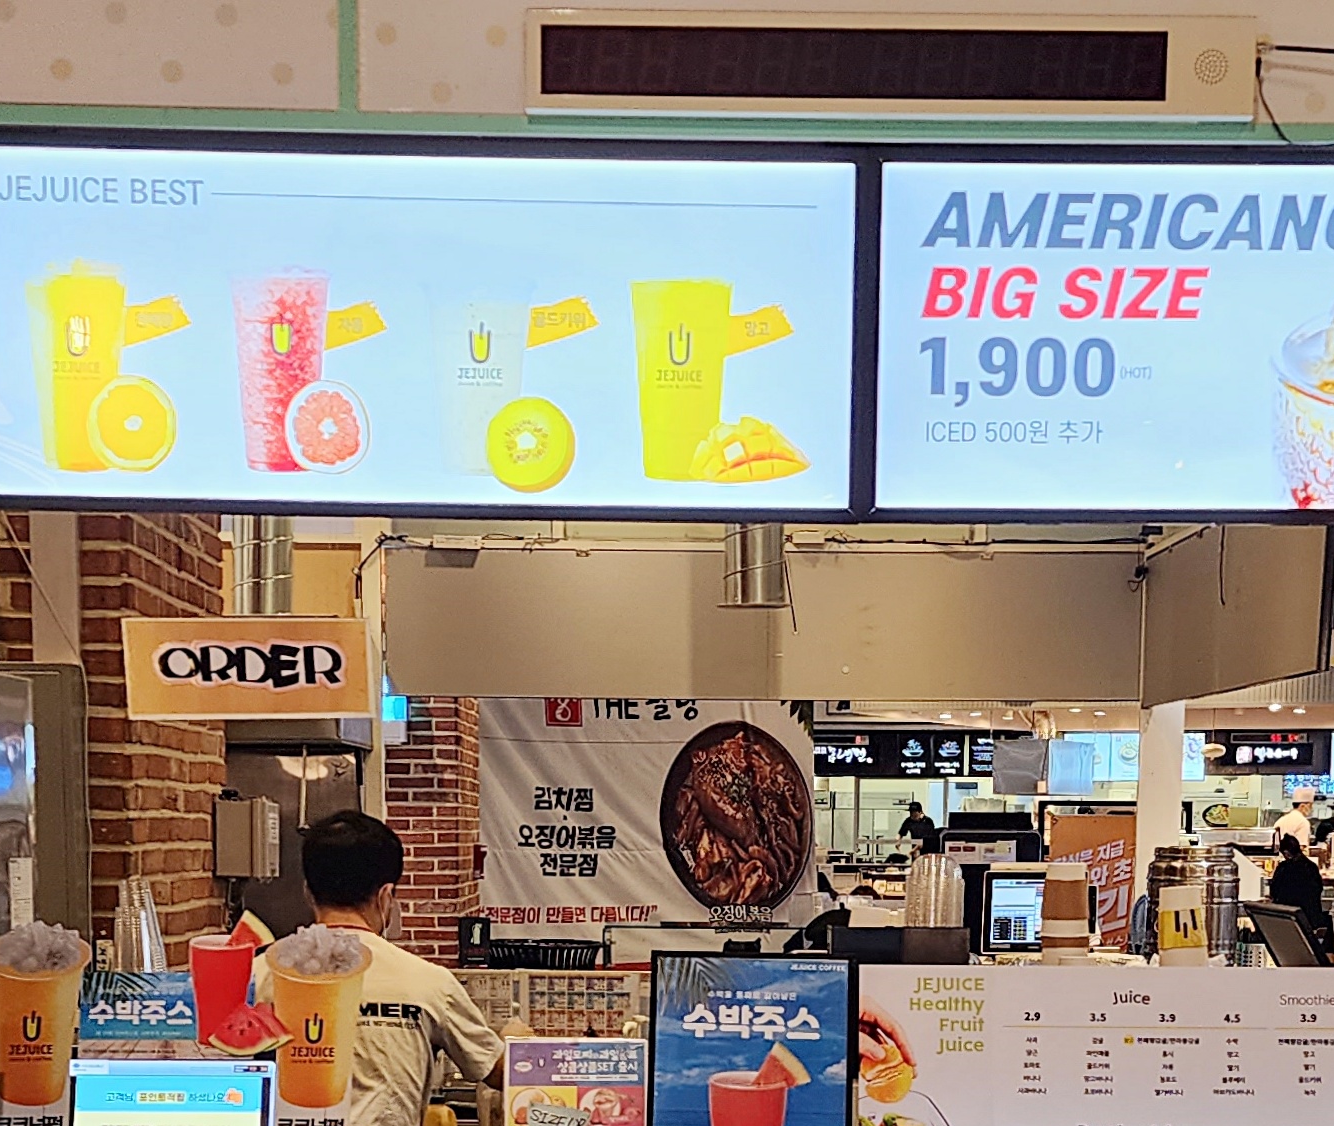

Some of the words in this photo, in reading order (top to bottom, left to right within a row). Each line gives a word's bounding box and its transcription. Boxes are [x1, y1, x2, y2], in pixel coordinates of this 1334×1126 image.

[130, 179, 204, 206] BEST
[921, 267, 1037, 320] BIG
[1059, 267, 1211, 320] SIZE
[744, 322, 769, 336] 망고
[457, 368, 503, 379] JEJUICE
[656, 369, 702, 382] JEJUICE
[919, 336, 1116, 407] 1,900
[1119, 366, 1152, 382] (HOT)
[925, 420, 977, 445] ICED
[983, 420, 1049, 446] 500원
[1057, 419, 1104, 446] 추가
[158, 644, 342, 688] ORDER
[534, 787, 594, 813] 김치찜
[518, 825, 616, 849] 오징어볶음
[540, 853, 598, 877] 전문점
[546, 906, 586, 923] 만들면
[819, 964, 846, 972] COFFEE
[914, 978, 985, 992] JEJUICE
[909, 997, 985, 1016] Healthy
[1112, 990, 1150, 1006] Juice
[88, 1000, 192, 1025] 수박주스
[1024, 1012, 1041, 1022] 2.9
[1089, 1013, 1107, 1022] 3.5
[1159, 1013, 1176, 1023] 3.9
[1223, 1014, 1241, 1023] 4.5
[1300, 1014, 1317, 1023] 3.9
[682, 1004, 820, 1040] 수박주스
[939, 1018, 984, 1032] Fruit
[8, 1044, 53, 1055] JEJUICE
[290, 1046, 335, 1058] JEJUICE
[937, 1037, 984, 1055] Juice
